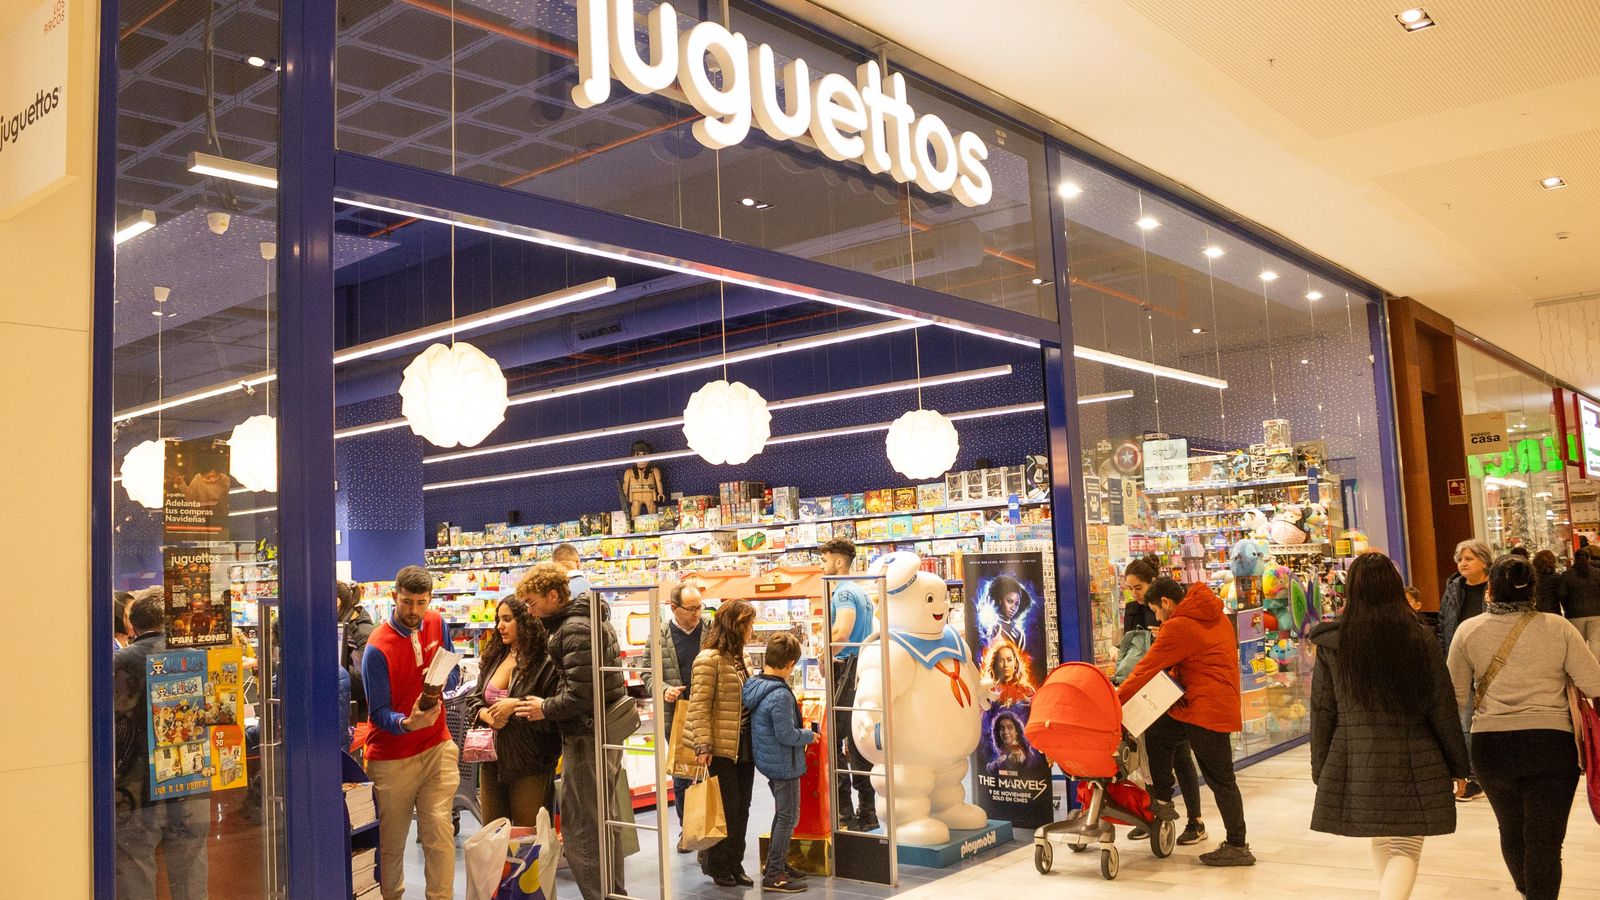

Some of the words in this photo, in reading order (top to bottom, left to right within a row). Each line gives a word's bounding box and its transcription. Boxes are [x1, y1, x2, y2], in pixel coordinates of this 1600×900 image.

[43, 10, 65, 36] ARCOS
[571, 0, 993, 208] juguettos
[1471, 434, 1501, 444] casa
[165, 499, 201, 508] Adelanta
[165, 515, 206, 523] Navideñas
[170, 553, 222, 567] juguettos
[978, 775, 995, 787] THE
[998, 778, 1048, 800] MARVELS
[961, 831, 996, 858] playmobil
